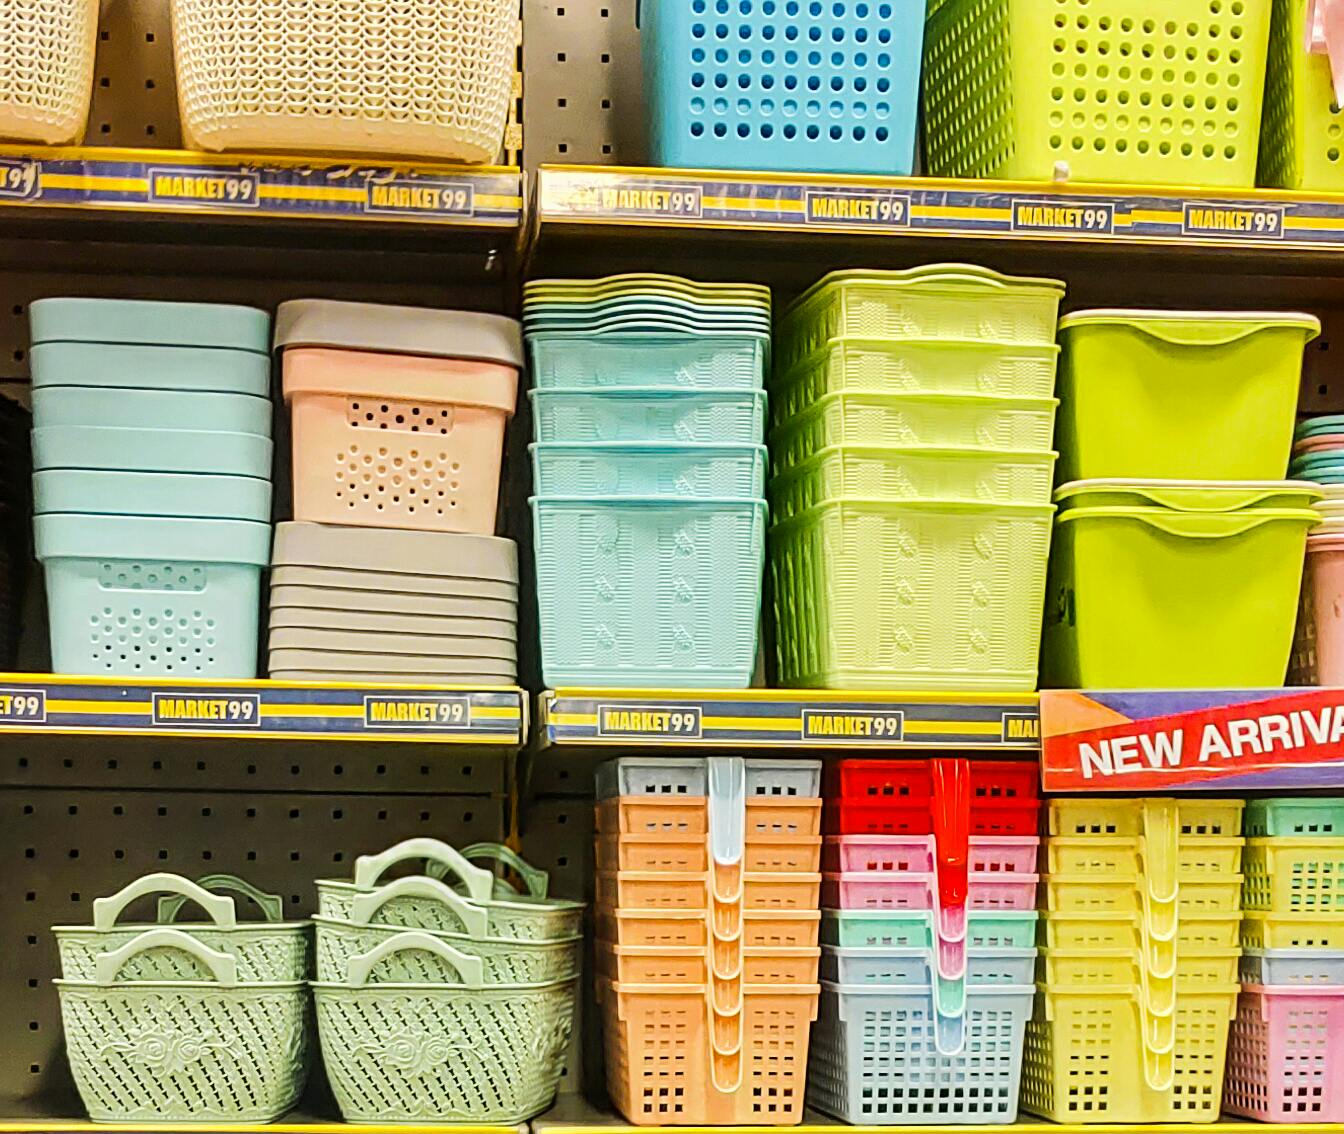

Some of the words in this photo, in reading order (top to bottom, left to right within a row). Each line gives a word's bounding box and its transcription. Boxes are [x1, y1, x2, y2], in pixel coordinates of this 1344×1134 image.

[155, 176, 253, 200] MARKET99
[371, 188, 467, 209] MARKET99
[603, 188, 696, 212] MARKET99
[812, 196, 903, 221] MARKET99
[1017, 205, 1107, 229] MARKET99
[1188, 208, 1278, 233] MARKET99
[158, 699, 254, 721] MARKET99
[370, 701, 464, 723] MARKET99
[604, 710, 695, 733] MARKET99
[808, 715, 897, 737] MARKET99
[1079, 730, 1183, 778] NEW
